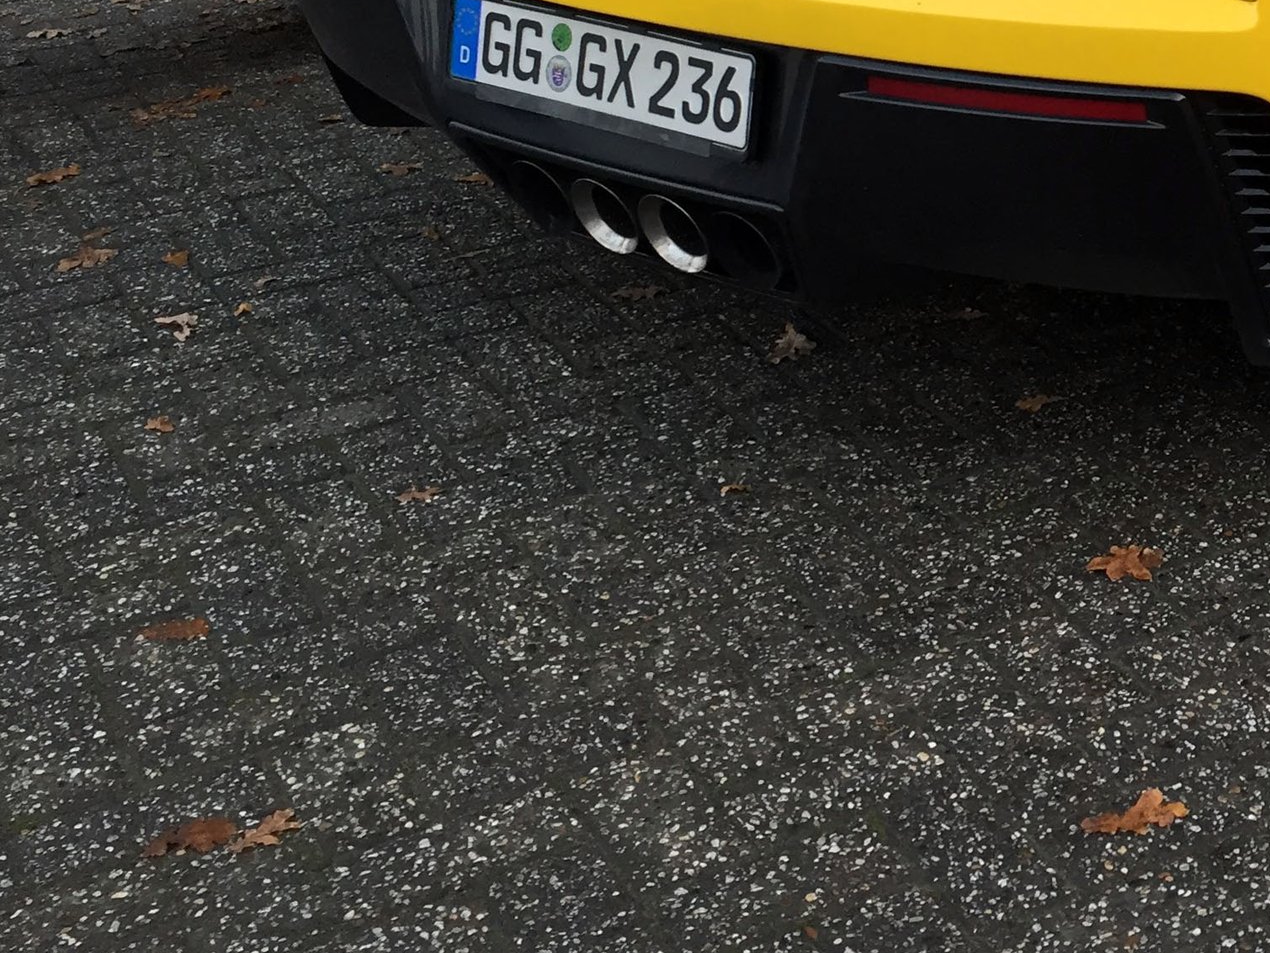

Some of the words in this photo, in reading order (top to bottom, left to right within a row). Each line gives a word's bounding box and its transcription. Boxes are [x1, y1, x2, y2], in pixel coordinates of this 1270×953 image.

[459, 45, 469, 63] D
[481, 11, 543, 84] GG
[576, 32, 641, 109] GX
[648, 50, 742, 133] 236
